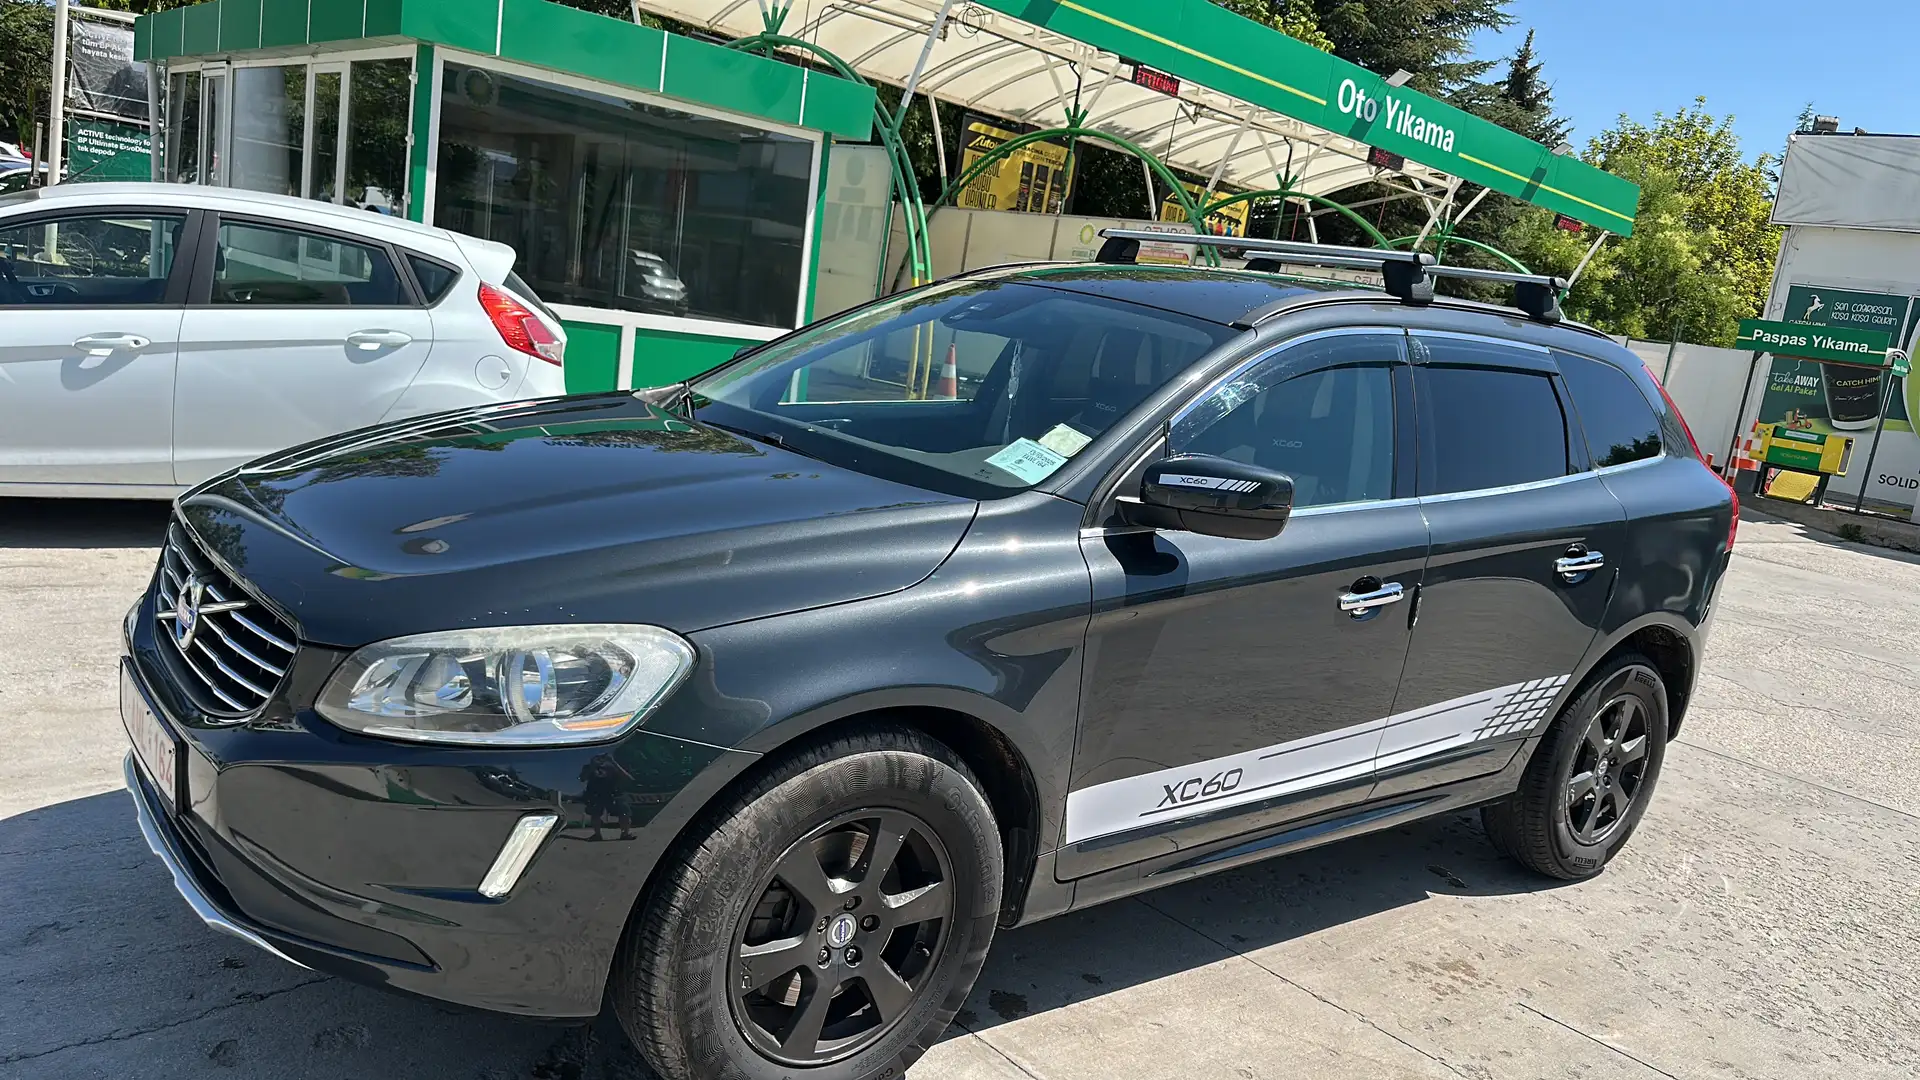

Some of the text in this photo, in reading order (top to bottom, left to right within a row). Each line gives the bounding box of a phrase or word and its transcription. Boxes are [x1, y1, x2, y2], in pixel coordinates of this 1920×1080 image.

[1338, 78, 1455, 153] Oto Yıkama
[77, 128, 105, 139] ACTIVE
[105, 133, 143, 146] technology
[1752, 328, 1869, 353] Paspas Yıkama
[1793, 375, 1820, 388] AWAY
[1836, 378, 1864, 387] CATCH
[1770, 382, 1784, 392] Gel
[1794, 386, 1818, 397] Paket
[1094, 401, 1117, 412] XC60
[1272, 438, 1303, 448] XC60
[1180, 476, 1208, 485] XC60
[1878, 474, 1919, 490] SOLID
[1156, 767, 1243, 808] XC60
